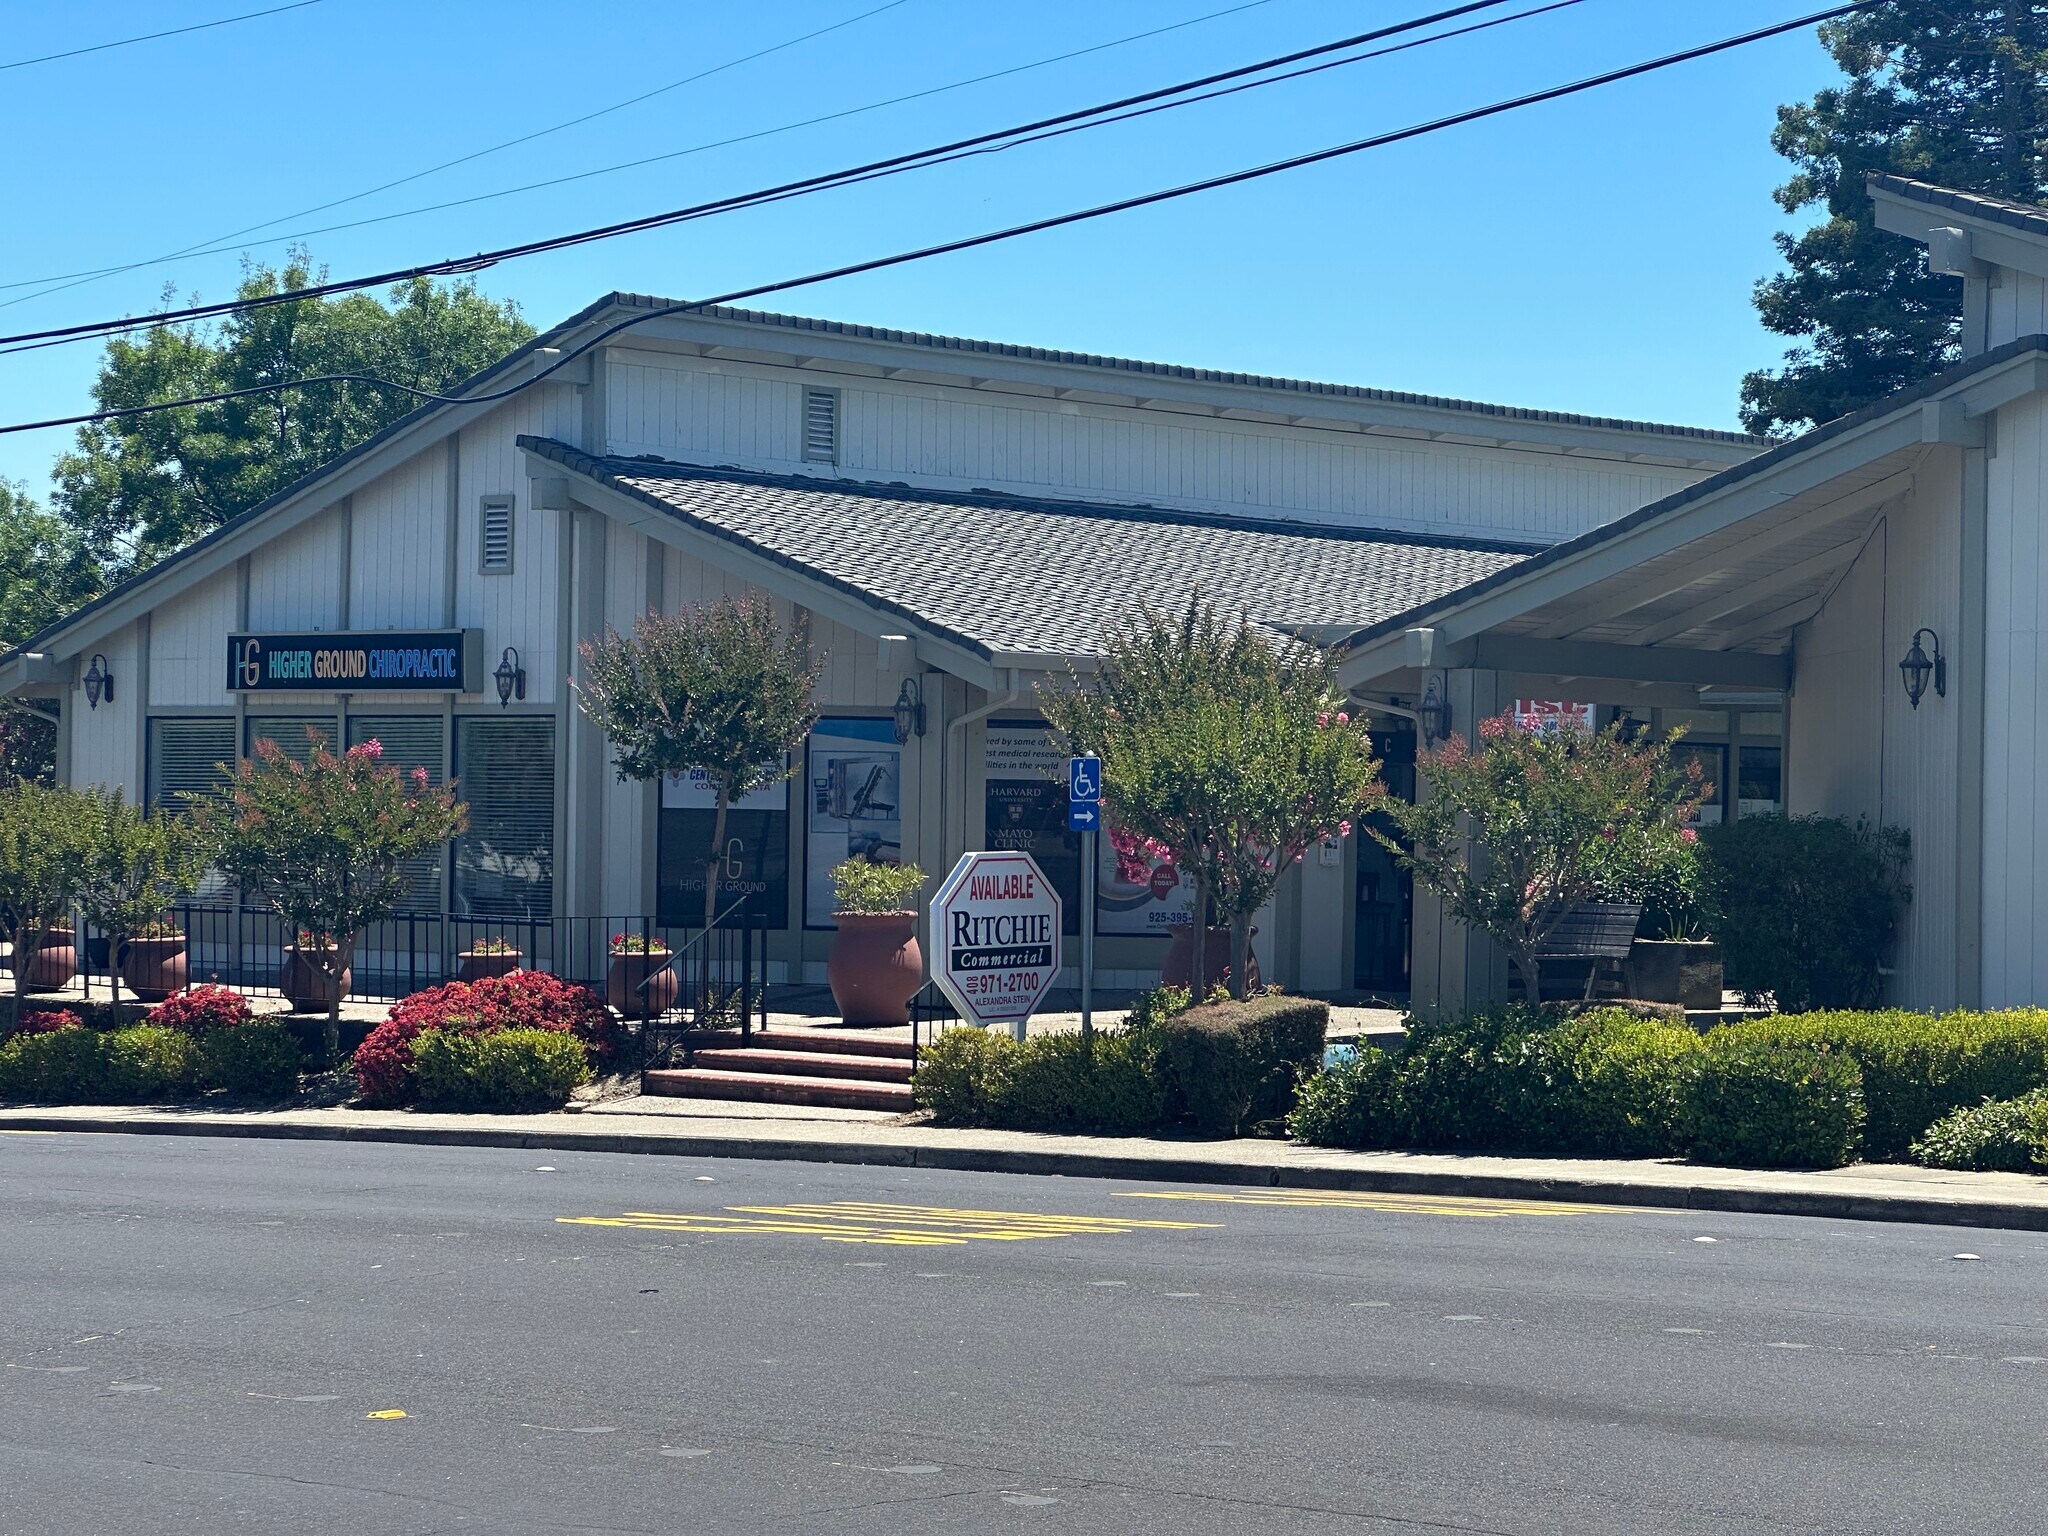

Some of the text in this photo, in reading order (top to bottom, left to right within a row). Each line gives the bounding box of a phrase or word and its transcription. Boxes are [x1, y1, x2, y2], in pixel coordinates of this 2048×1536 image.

[268, 650, 313, 679] HIGHER
[314, 649, 367, 678] GROUND
[368, 648, 457, 678] CHIROPRACTIC
[1001, 737, 1012, 747] by
[1037, 737, 1048, 747] of
[998, 749, 1031, 758] medical
[1008, 761, 1017, 769] in
[1019, 761, 1033, 769] the
[1035, 761, 1059, 770] world
[991, 787, 1042, 797] HARVARD
[997, 828, 1033, 838] MAYO
[994, 839, 1036, 848] CLINIC
[679, 879, 767, 893] HIGHR GROUND
[969, 873, 1034, 901] AVAILABLE
[951, 910, 1052, 947] RITCHIE
[960, 948, 1043, 968] Commercial
[980, 971, 1039, 994] 971-2700
[974, 995, 1031, 1006] ALEXANDRA STEIN
